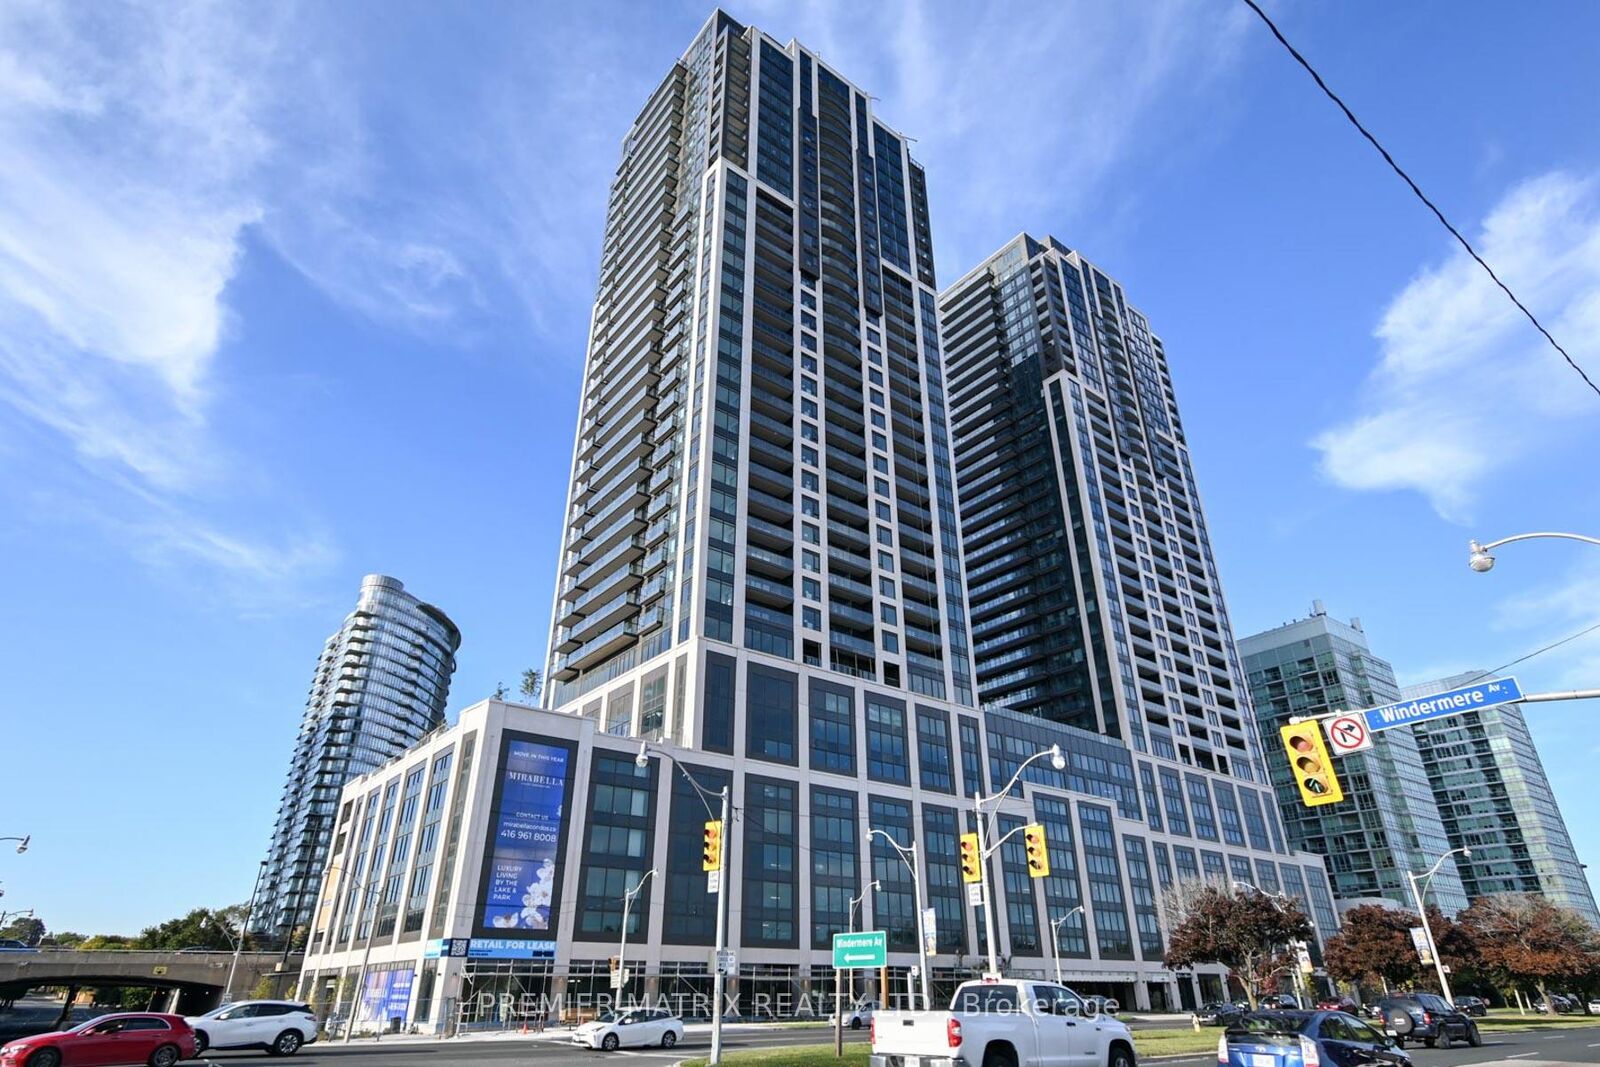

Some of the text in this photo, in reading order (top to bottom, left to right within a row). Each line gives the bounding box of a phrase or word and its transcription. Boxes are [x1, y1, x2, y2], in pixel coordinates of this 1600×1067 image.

[1380, 683, 1500, 723] Windermere Av
[509, 771, 563, 787] MIRABELLA
[515, 811, 540, 820] CONTACT
[501, 829, 557, 843] 416 961 8008
[497, 864, 522, 872] LUXURY
[496, 871, 518, 880] LIVING
[495, 878, 518, 887] BY THE
[494, 886, 511, 894] LAKE
[493, 893, 511, 901] PARK
[470, 940, 556, 951] RETAIL FOR LEASE
